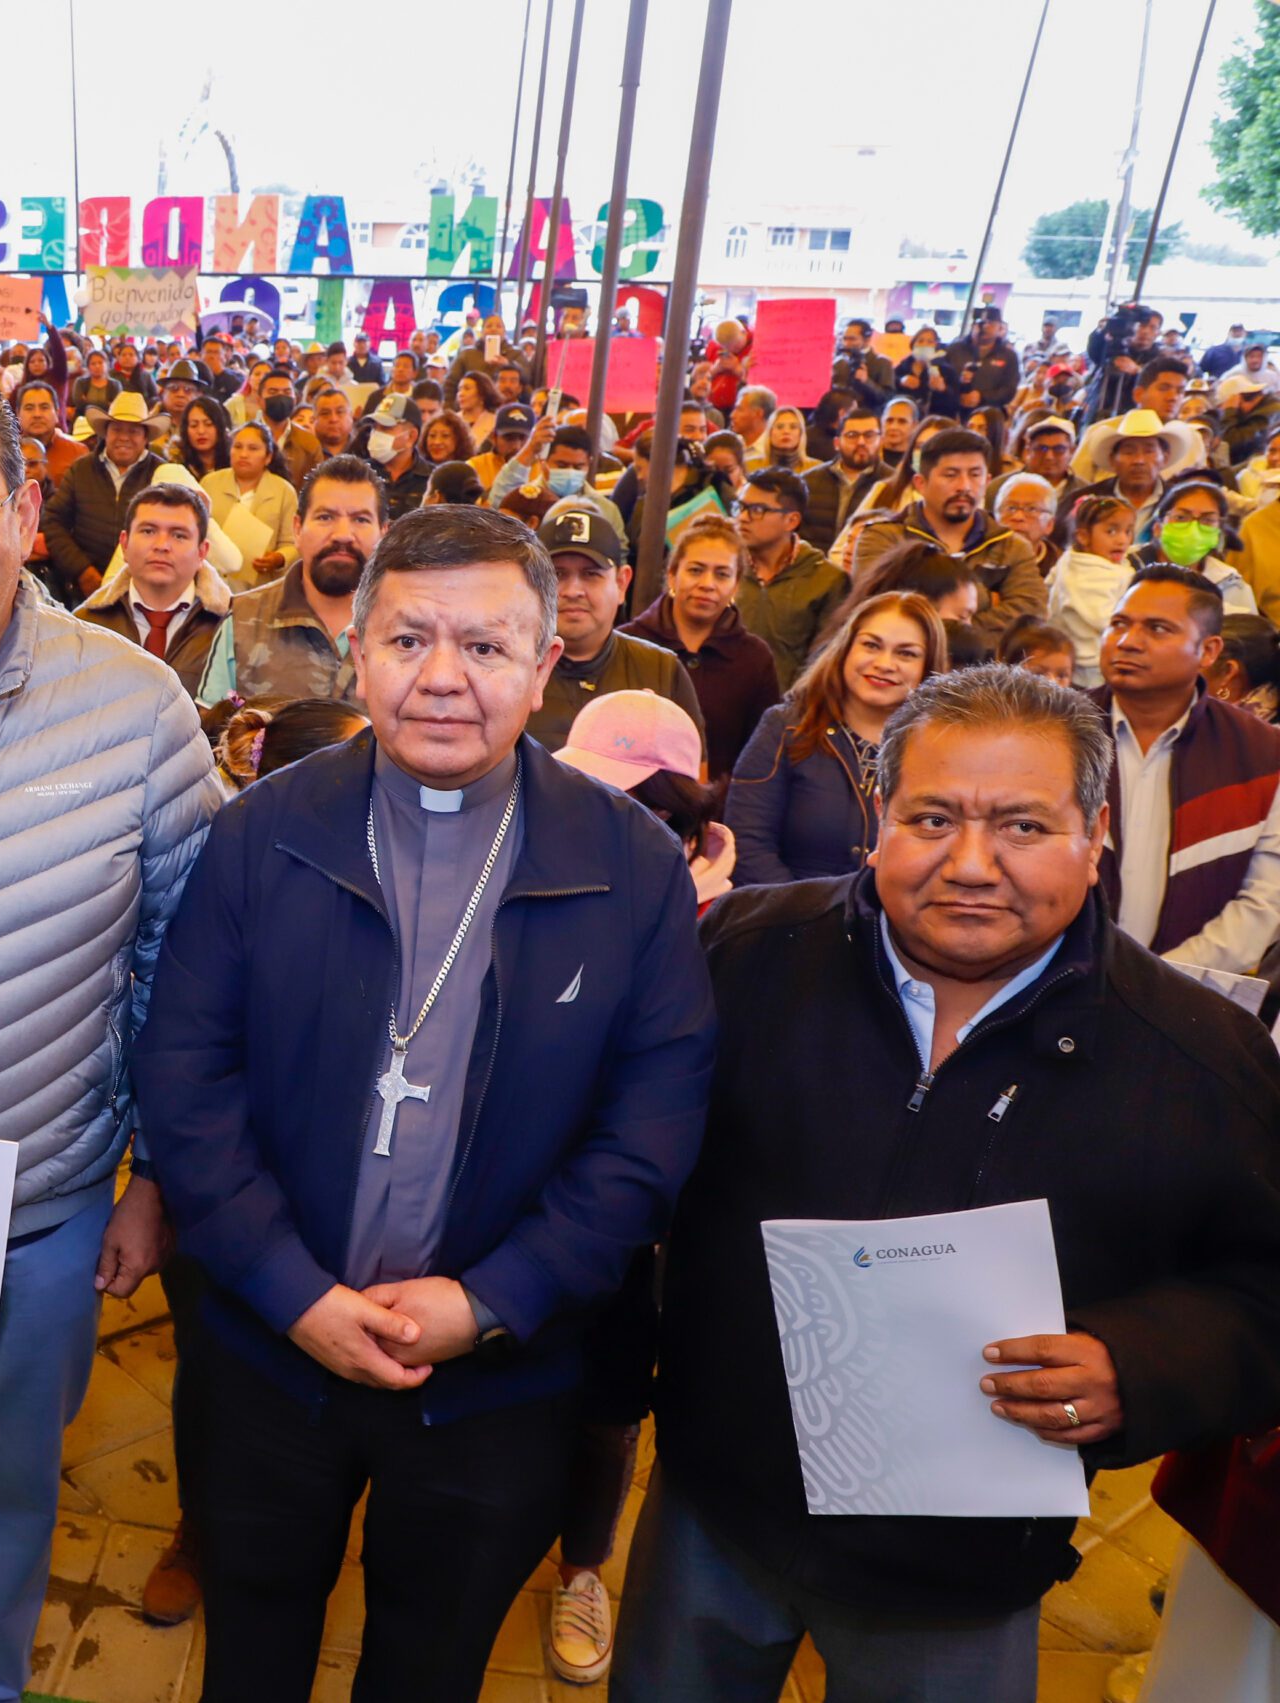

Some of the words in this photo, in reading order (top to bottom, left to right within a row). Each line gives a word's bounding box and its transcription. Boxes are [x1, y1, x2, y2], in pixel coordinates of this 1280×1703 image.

[91, 275, 195, 303] Bienvenido
[100, 303, 184, 328] gobernador
[876, 1243, 956, 1259] CONAGUA
